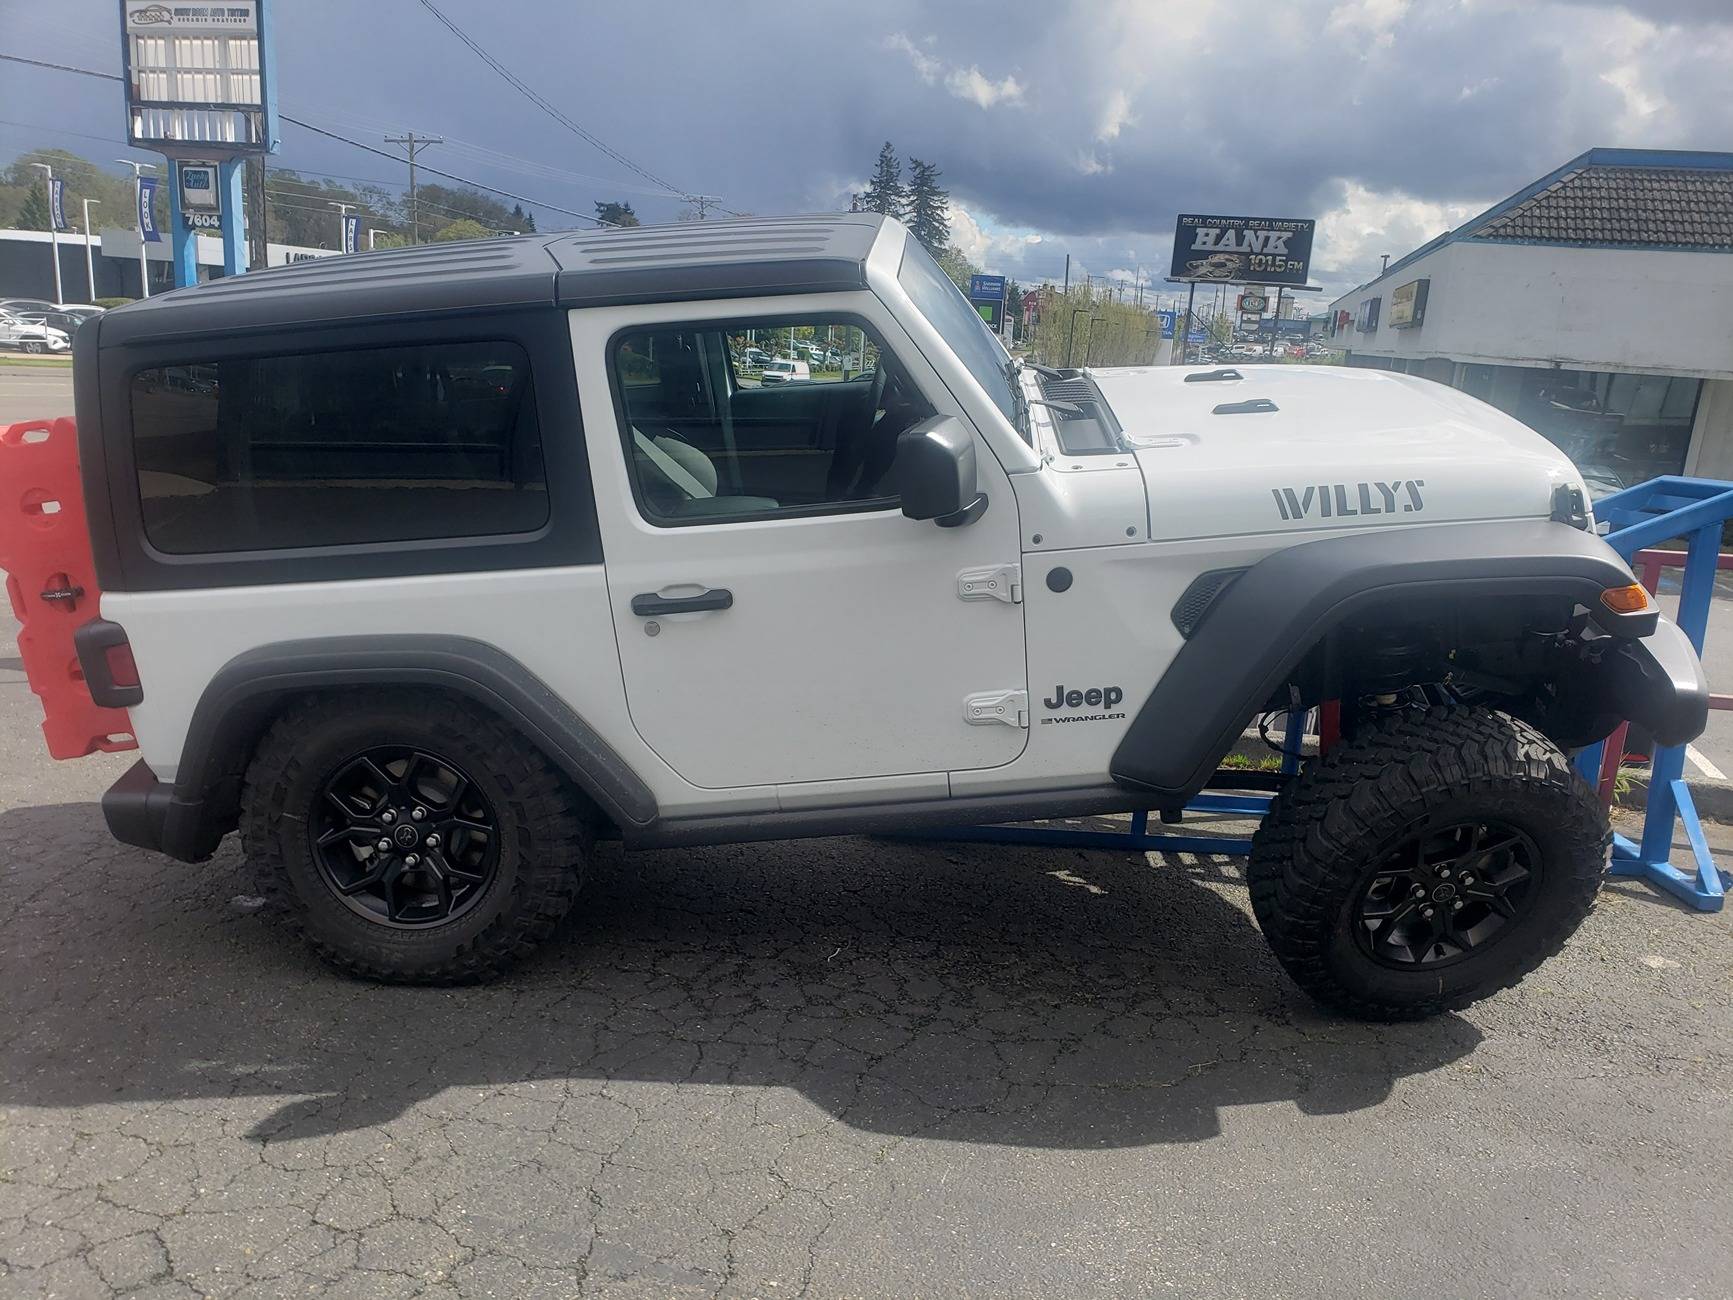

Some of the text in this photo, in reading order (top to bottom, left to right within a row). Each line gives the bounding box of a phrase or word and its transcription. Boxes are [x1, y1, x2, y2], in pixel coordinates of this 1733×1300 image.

[143, 189, 152, 230] LOOK
[185, 214, 220, 228] 7604
[347, 219, 355, 253] LARS
[1181, 217, 1203, 226] REAL
[1248, 219, 1270, 230] REAL
[1190, 227, 1294, 255] HANK
[1248, 254, 1304, 273] 101.5 FM
[1271, 480, 1425, 521] WILLYS
[1043, 685, 1124, 710] Jeep
[1053, 713, 1126, 724] WRANGLER
